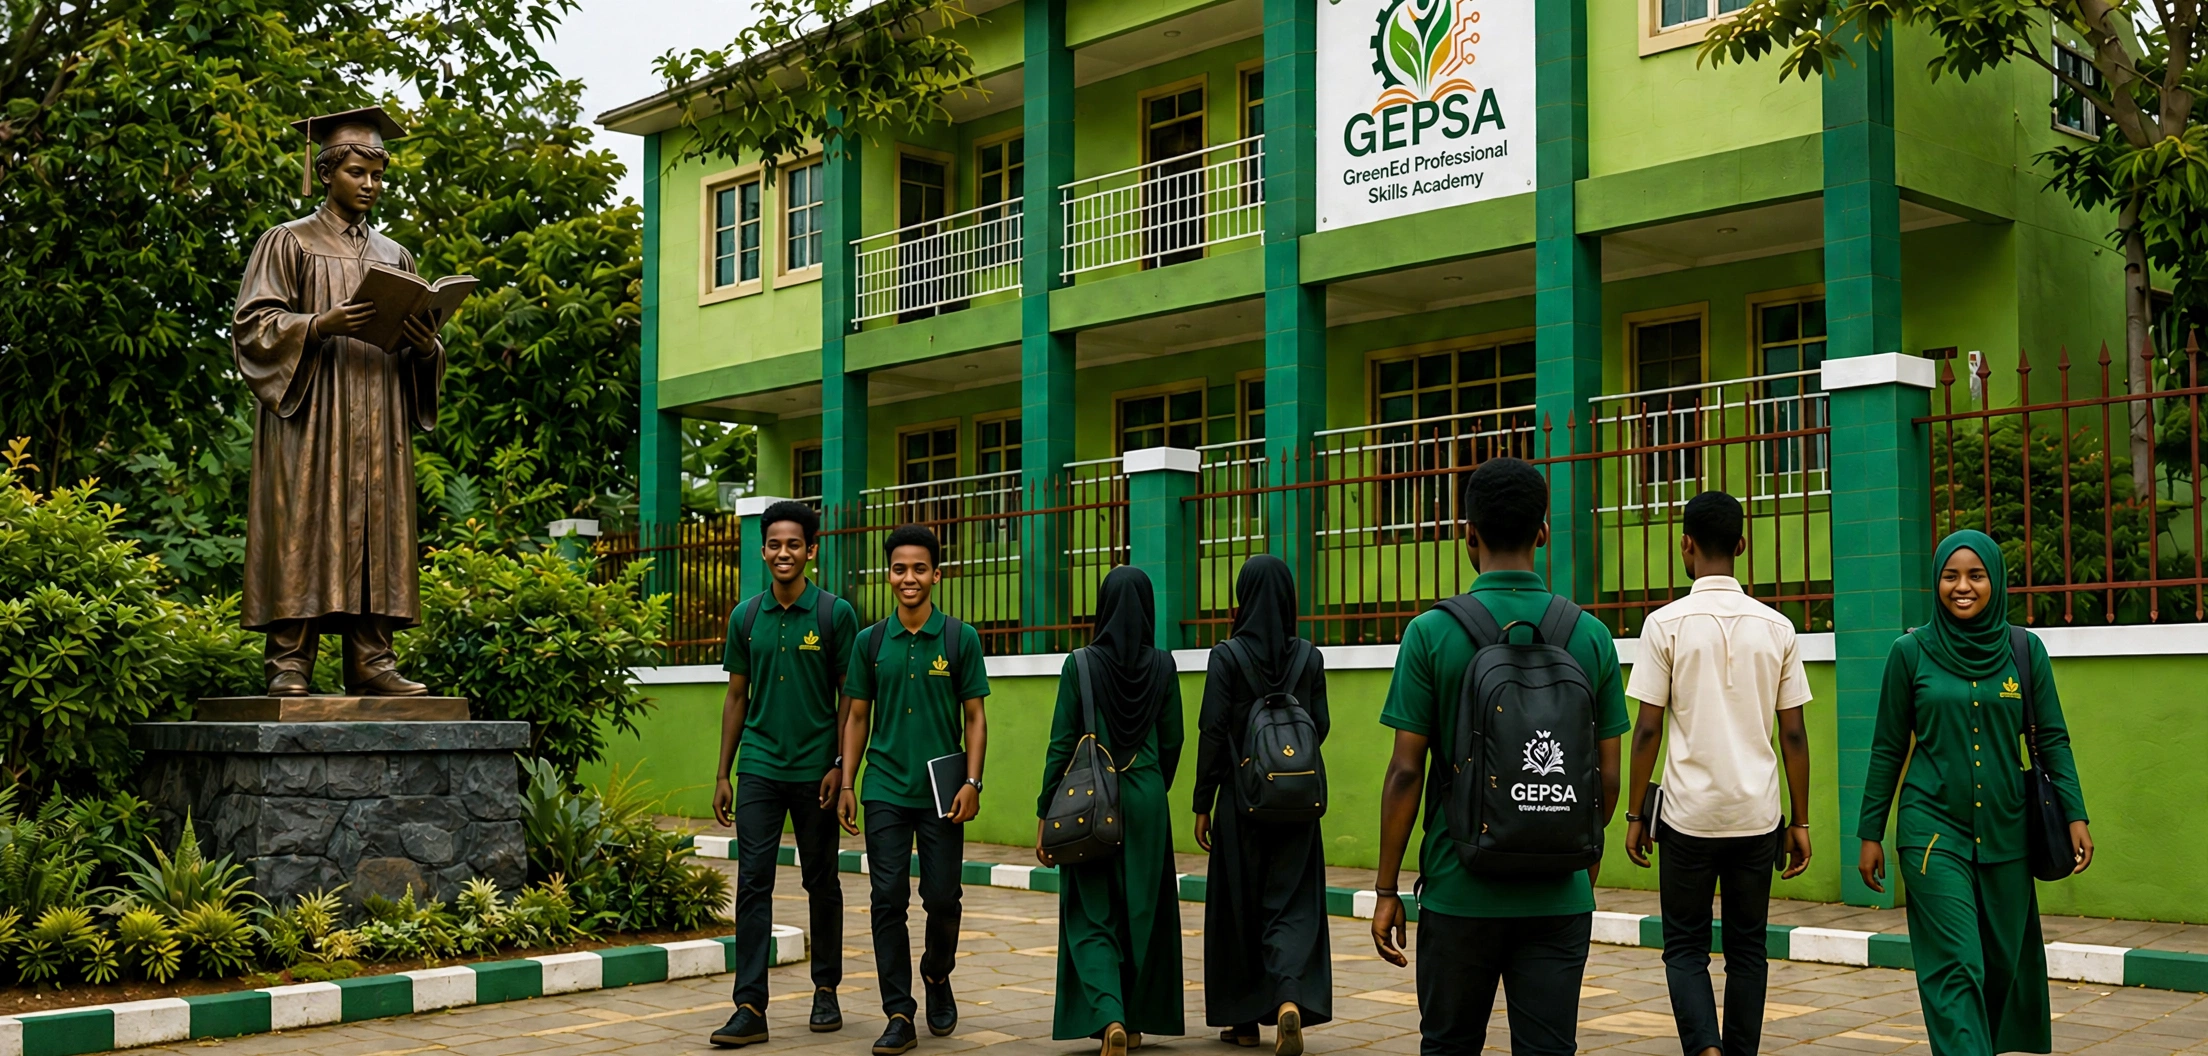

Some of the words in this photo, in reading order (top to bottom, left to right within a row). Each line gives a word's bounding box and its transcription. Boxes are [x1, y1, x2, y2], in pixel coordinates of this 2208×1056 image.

[1344, 88, 1506, 157] GEPSA
[1343, 158, 1410, 186] GreenEd
[1415, 140, 1508, 172] Professional
[1368, 183, 1408, 204] Skills
[1412, 172, 1484, 197] Academy
[1510, 783, 1578, 803] GEPSA
